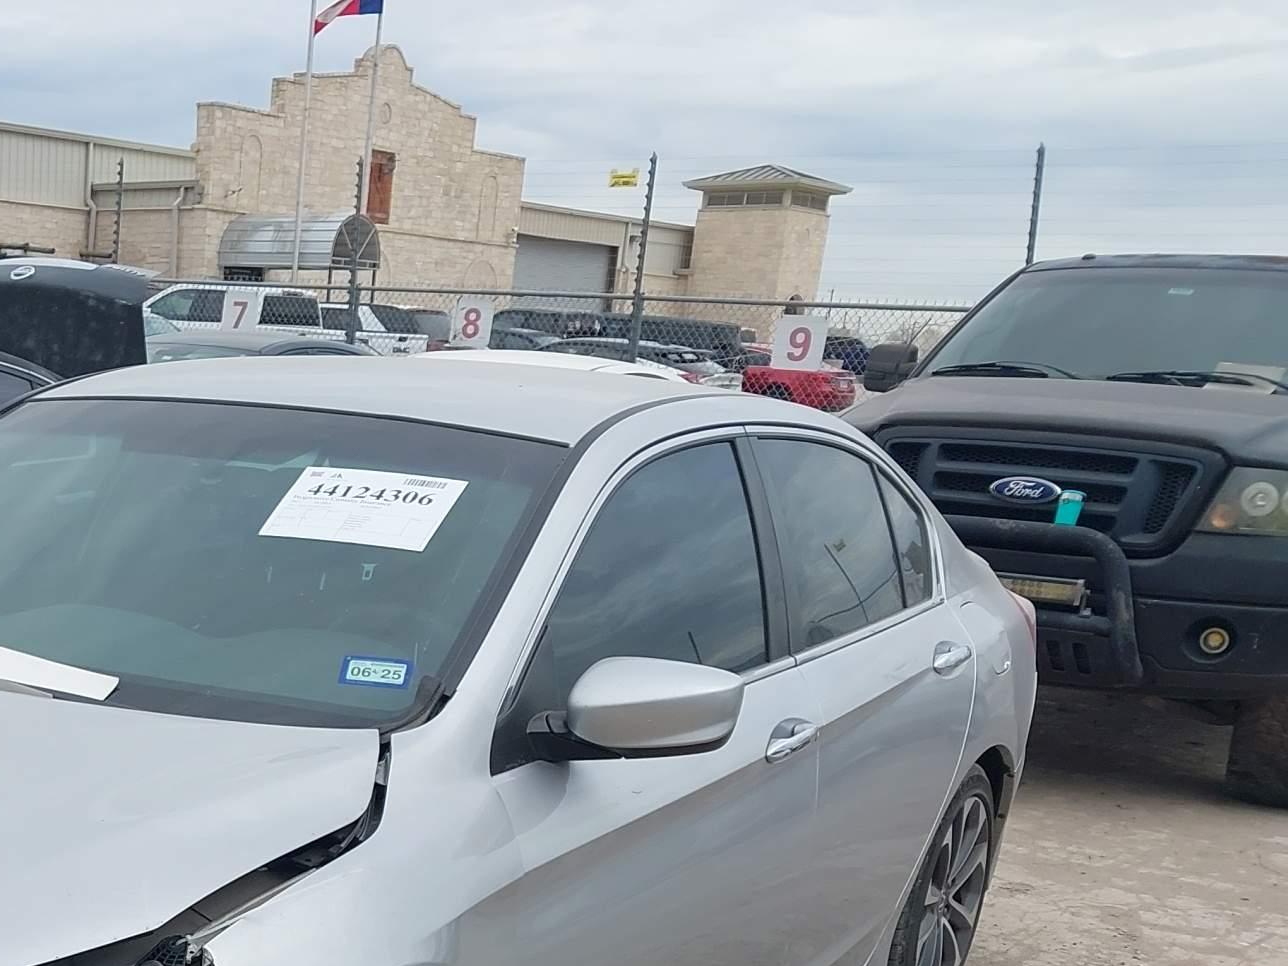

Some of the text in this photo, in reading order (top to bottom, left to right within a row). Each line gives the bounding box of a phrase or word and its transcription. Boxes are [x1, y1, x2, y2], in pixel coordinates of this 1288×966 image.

[233, 301, 248, 329] 7
[462, 307, 481, 338] 8
[787, 327, 811, 361] 9
[307, 482, 436, 506] 44124306
[1004, 480, 1045, 498] Ford
